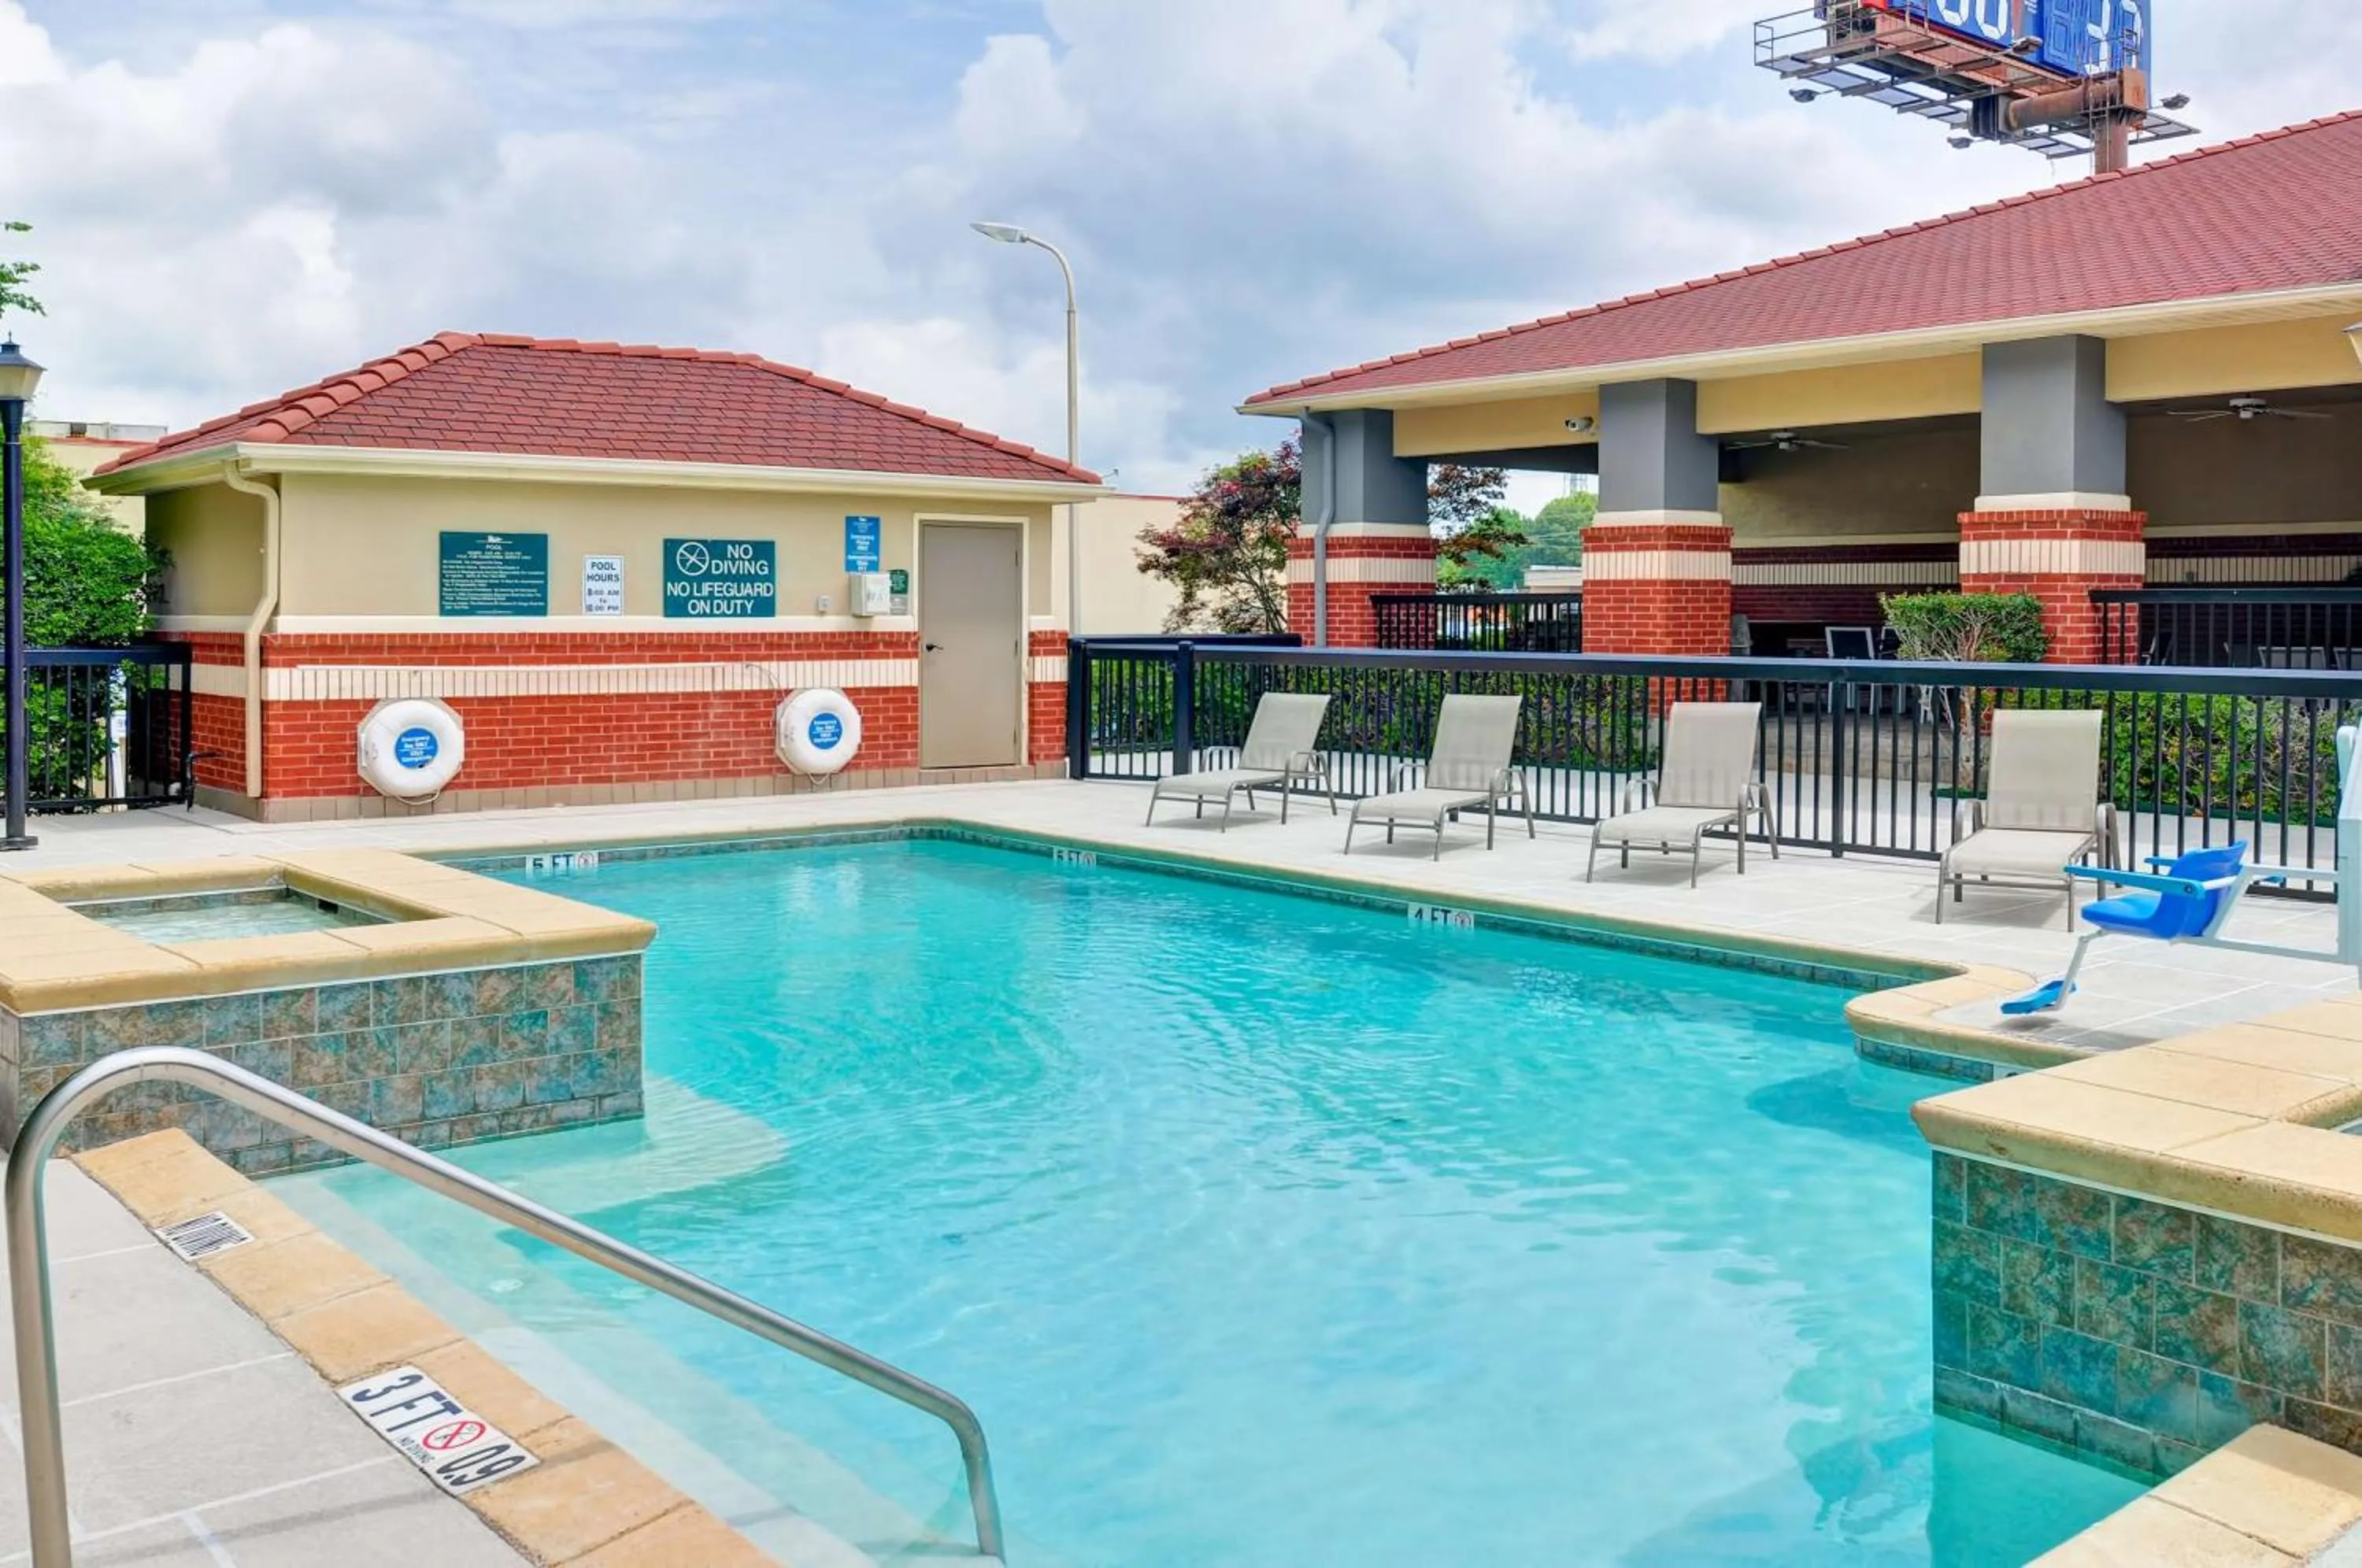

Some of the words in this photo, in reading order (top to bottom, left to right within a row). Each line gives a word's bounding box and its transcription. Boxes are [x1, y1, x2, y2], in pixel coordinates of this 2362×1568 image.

[727, 544, 753, 560] NO
[591, 561, 616, 571] POOL
[711, 560, 769, 575] DIVING
[587, 573, 620, 582] HOURS
[667, 581, 690, 597] NO
[693, 582, 773, 598] LIFEGUARD
[687, 599, 710, 615] ON
[713, 600, 754, 615] DUTY
[533, 857, 543, 868] 5
[552, 854, 574, 868] FT
[1431, 908, 1451, 925] FT
[352, 1374, 424, 1403] 3
[369, 1390, 462, 1432] FT
[435, 1444, 526, 1487] 0.9
